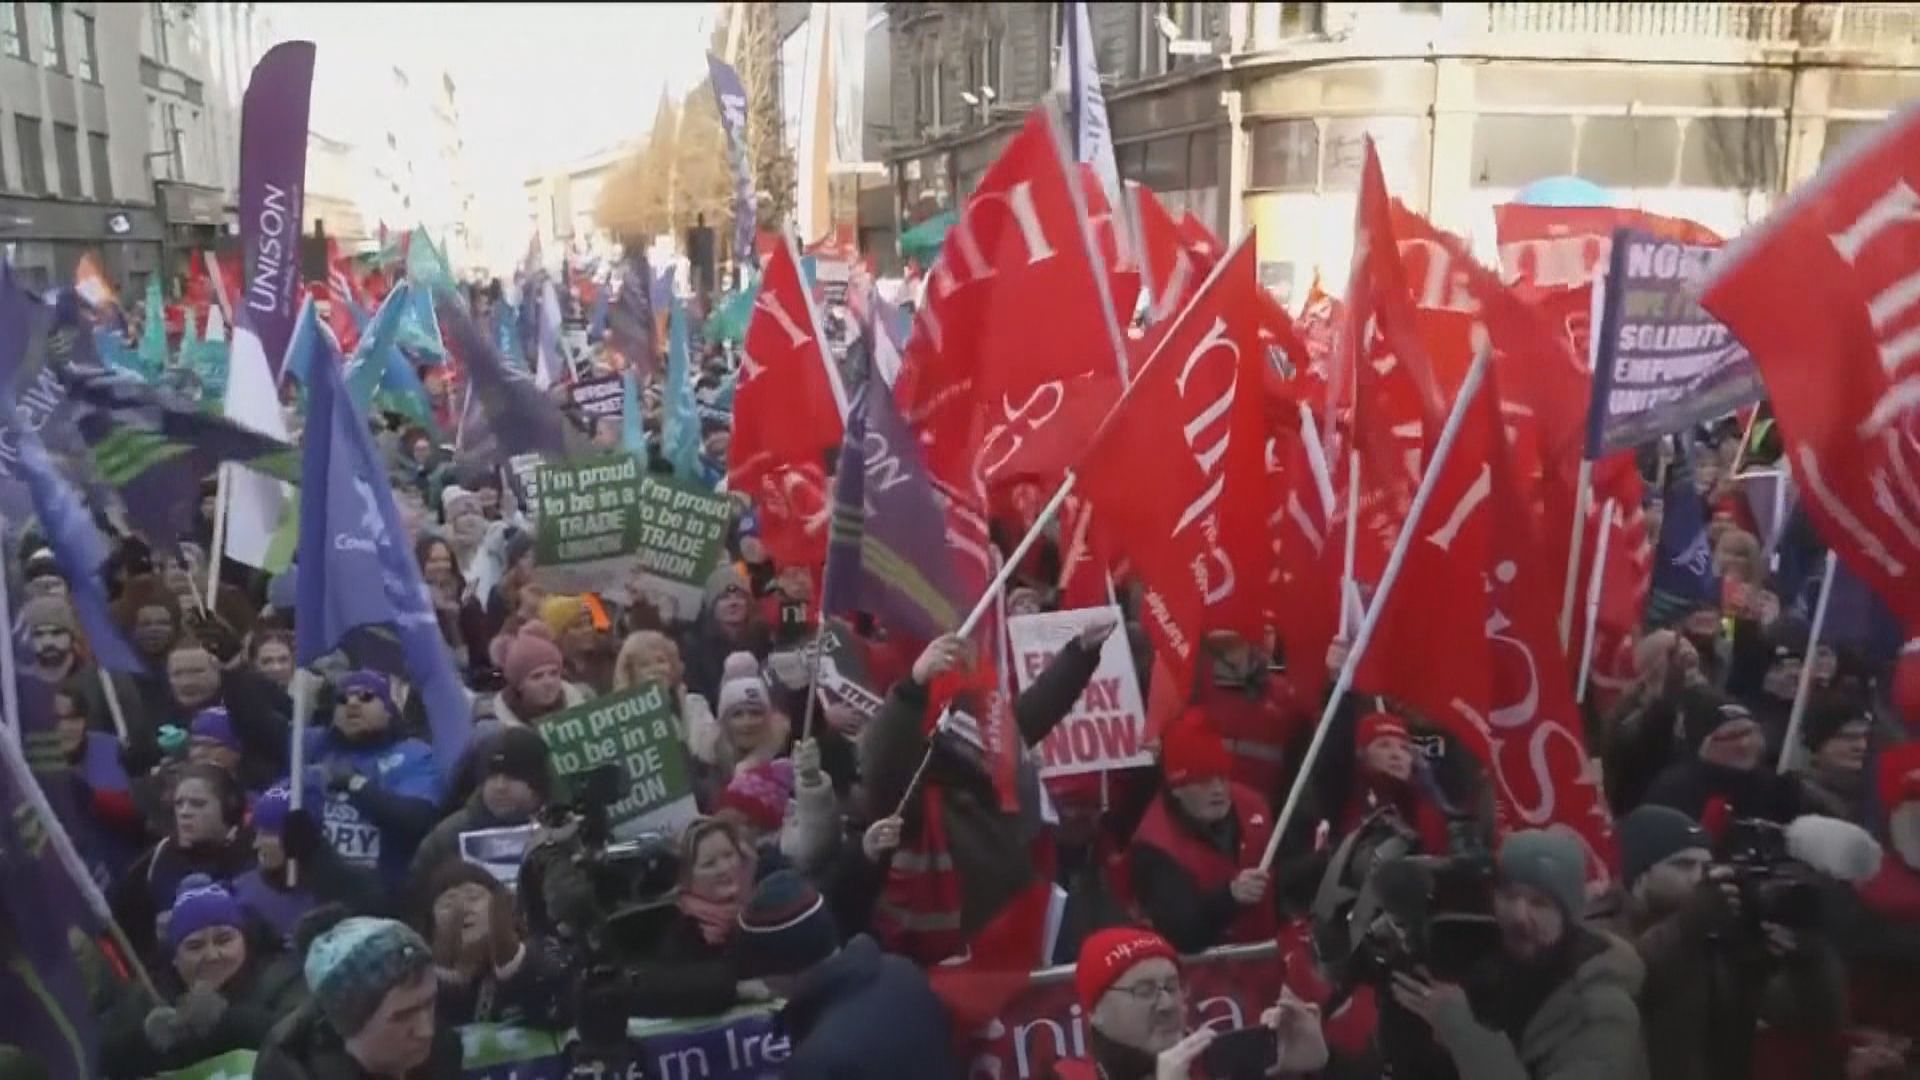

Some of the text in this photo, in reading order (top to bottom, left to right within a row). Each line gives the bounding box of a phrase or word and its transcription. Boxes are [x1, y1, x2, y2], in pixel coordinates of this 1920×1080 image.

[249, 183, 286, 312] UNISON
[541, 469, 573, 492] I'm
[578, 458, 636, 492] proud
[544, 486, 636, 516] to be in a
[641, 477, 731, 520] I'm proud
[559, 507, 626, 539] TRADE
[639, 523, 705, 560] TRADE
[657, 506, 682, 528] be
[685, 513, 704, 536] in
[706, 522, 721, 541] a
[1082, 677, 1122, 713] AY
[538, 684, 663, 748] I'm proud
[551, 719, 669, 776] to be in a
[1040, 713, 1138, 767] NOW
